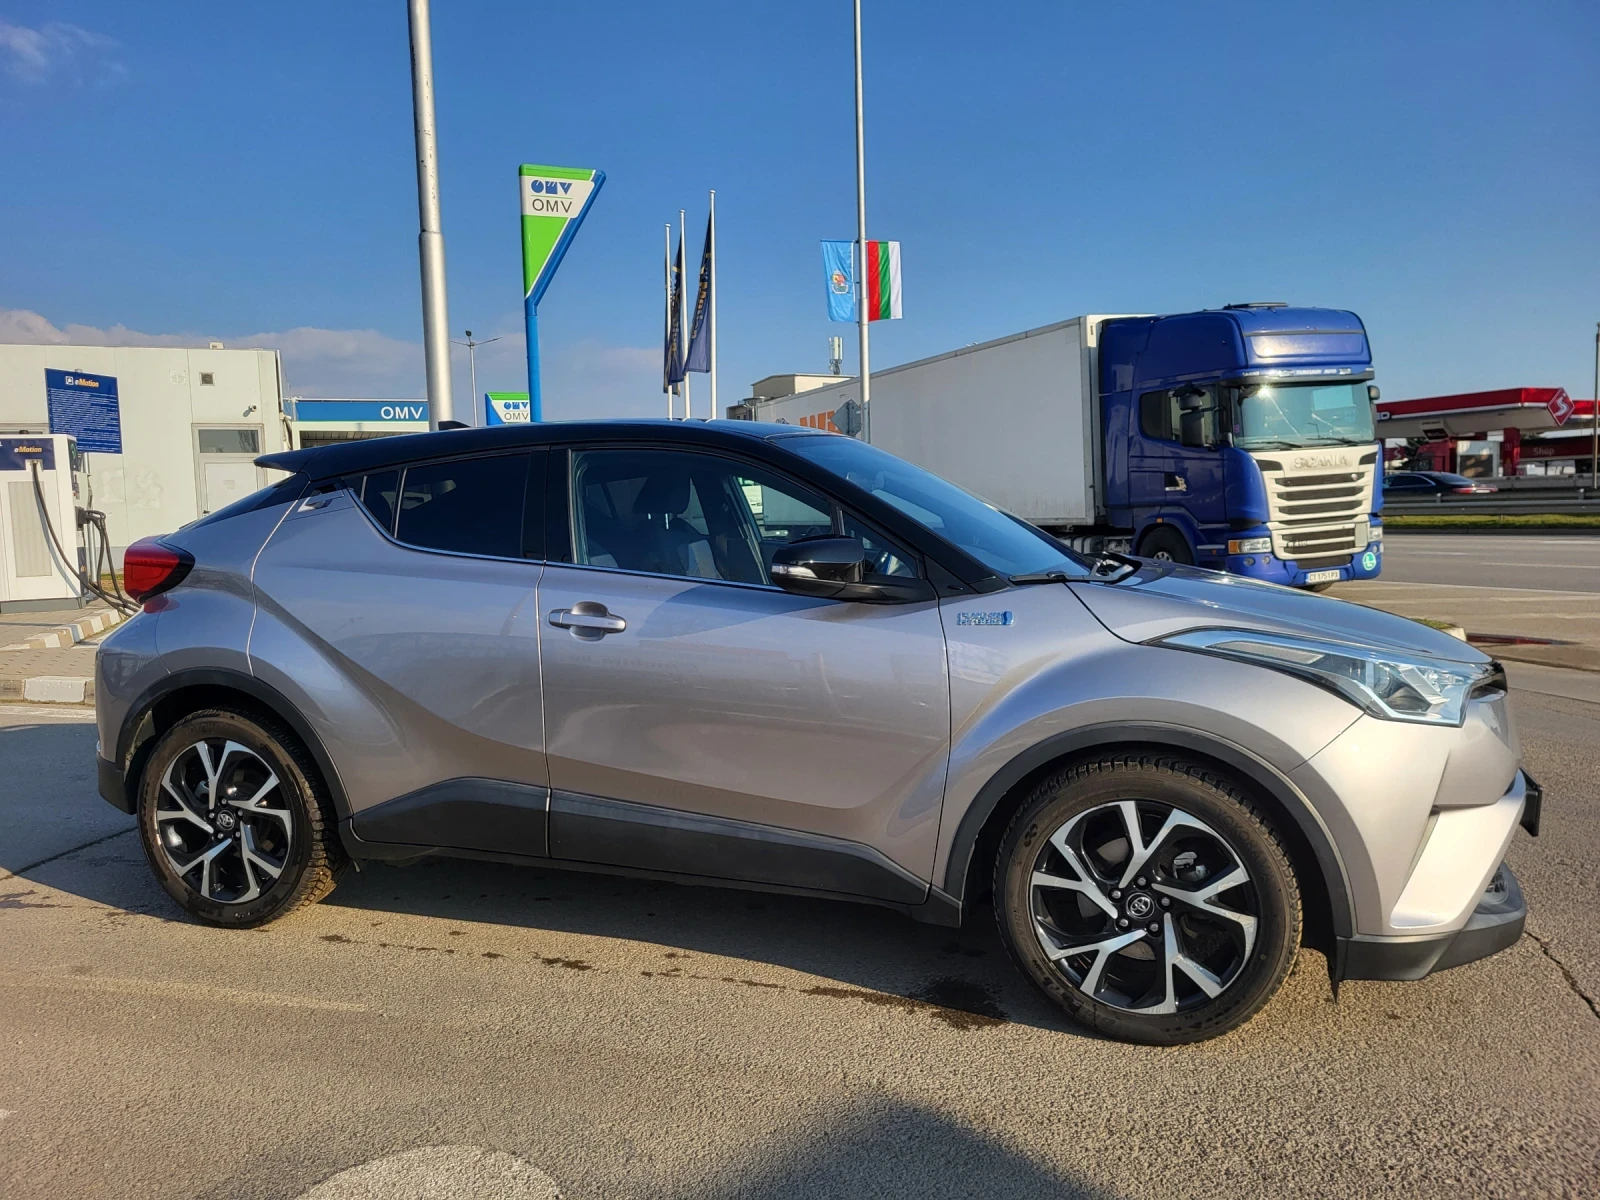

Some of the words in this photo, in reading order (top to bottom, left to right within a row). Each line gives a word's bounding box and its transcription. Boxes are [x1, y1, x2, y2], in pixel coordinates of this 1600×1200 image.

[532, 198, 573, 213] OMV
[74, 377, 100, 388] eMotion
[380, 406, 423, 420] OMV
[504, 412, 529, 421] OMV
[1533, 447, 1555, 457] Shop
[1294, 454, 1348, 469] SCANIA
